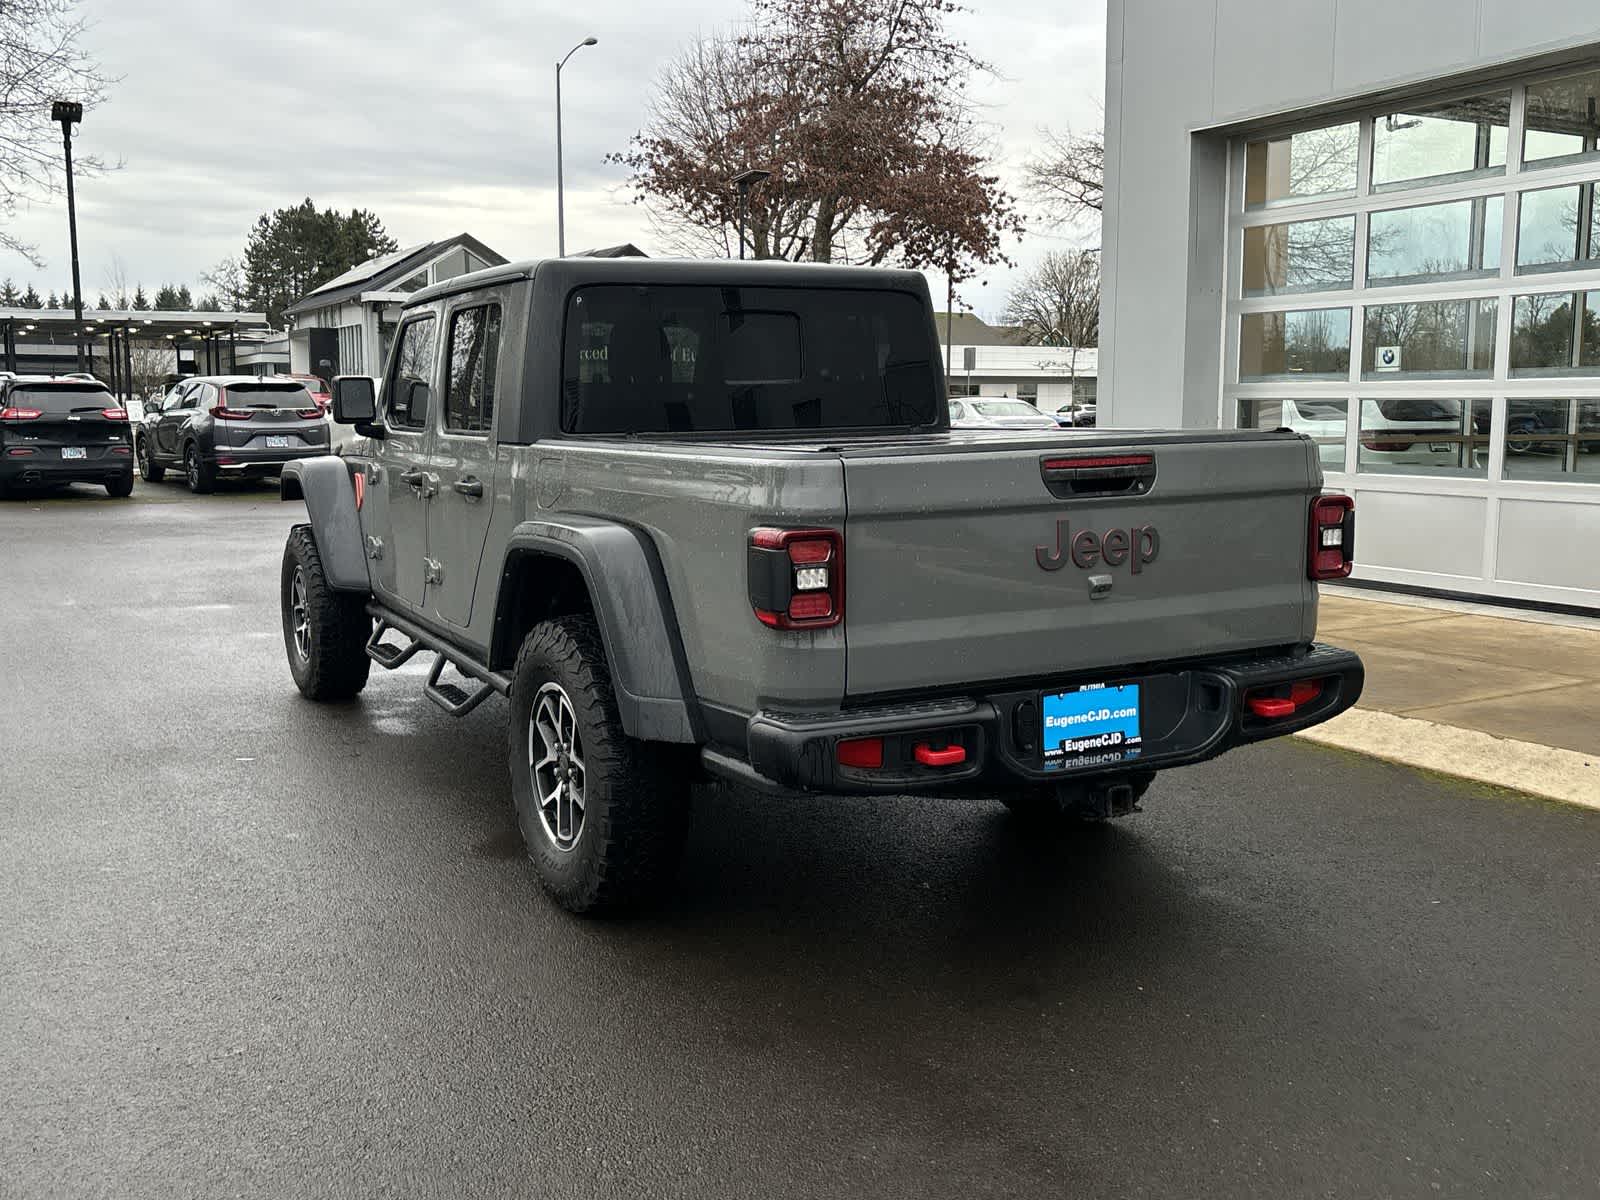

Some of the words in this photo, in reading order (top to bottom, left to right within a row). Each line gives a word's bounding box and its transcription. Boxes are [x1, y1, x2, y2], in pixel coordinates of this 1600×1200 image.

[1035, 519, 1160, 576] Jeep
[1045, 707, 1137, 728] EugeneCJD.com
[1065, 732, 1122, 752] EugeneCJD
